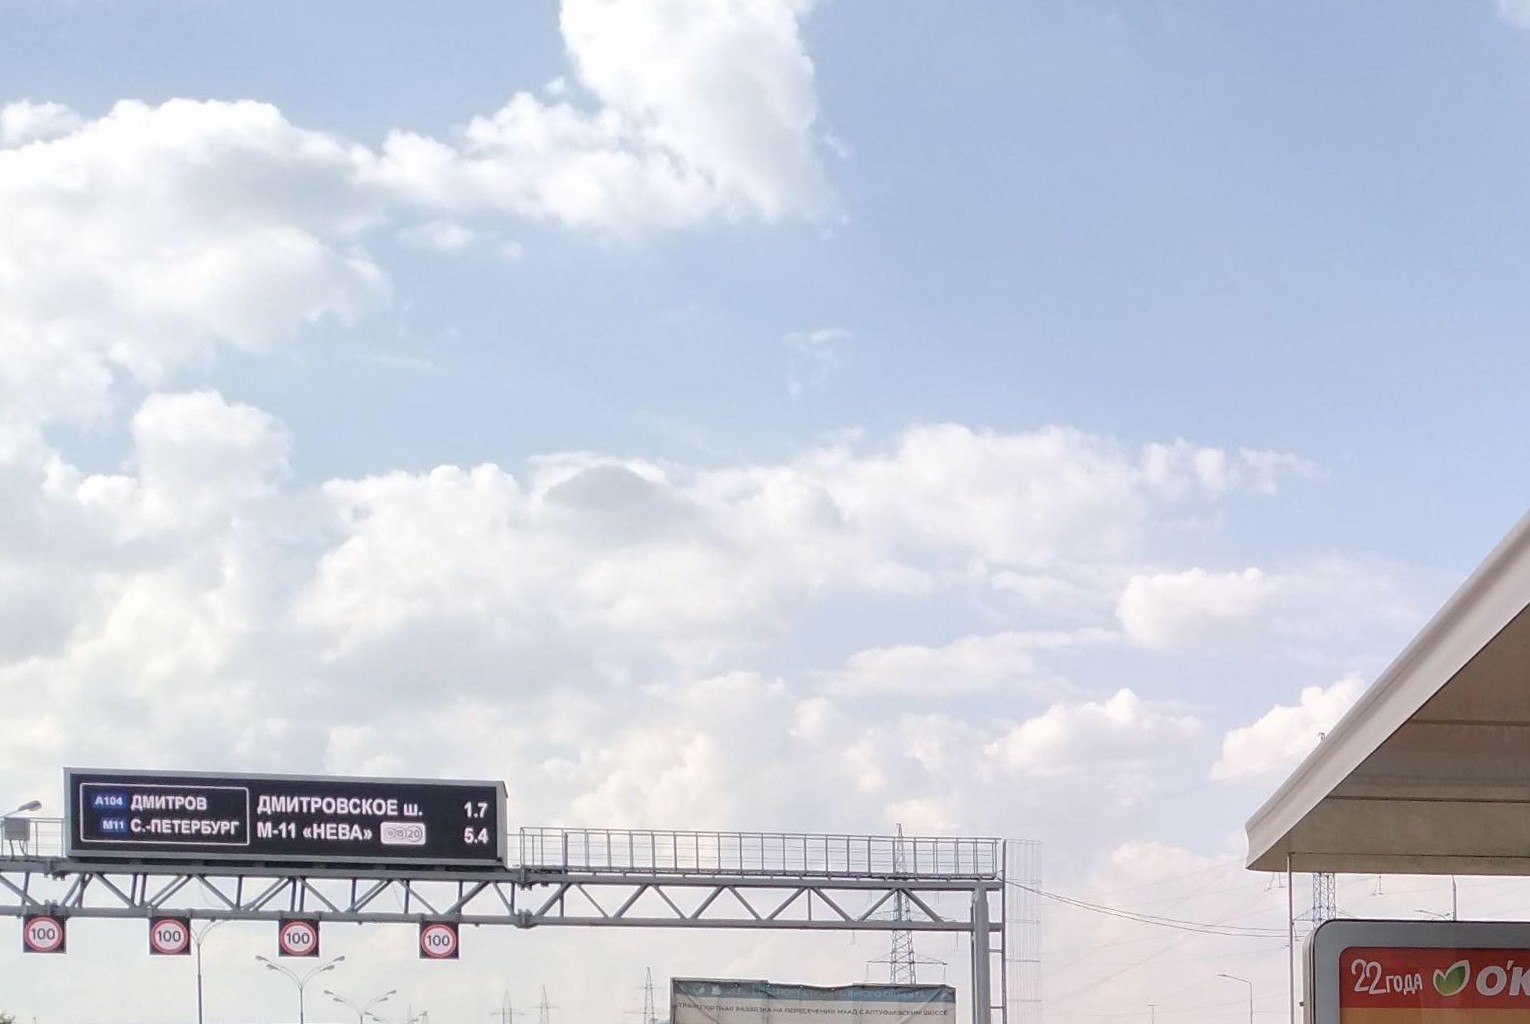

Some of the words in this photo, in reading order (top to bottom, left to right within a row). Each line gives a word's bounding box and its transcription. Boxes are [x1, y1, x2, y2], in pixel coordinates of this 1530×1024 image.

[131, 795, 207, 811] ДМИТРОВ
[256, 795, 399, 815] ДМИТРОВСКОЕ
[403, 803, 424, 816] ш.
[463, 801, 488, 818] 1.7
[130, 819, 239, 835] С.-ПЕТЕРБУРГ
[256, 822, 296, 839] М-11
[302, 823, 373, 840] «НЕВА»
[408, 829, 421, 839] 20
[463, 828, 489, 844] 5.4
[31, 928, 56, 940] 100
[157, 930, 182, 943] 100
[286, 932, 310, 945] 100
[427, 934, 450, 947] 100
